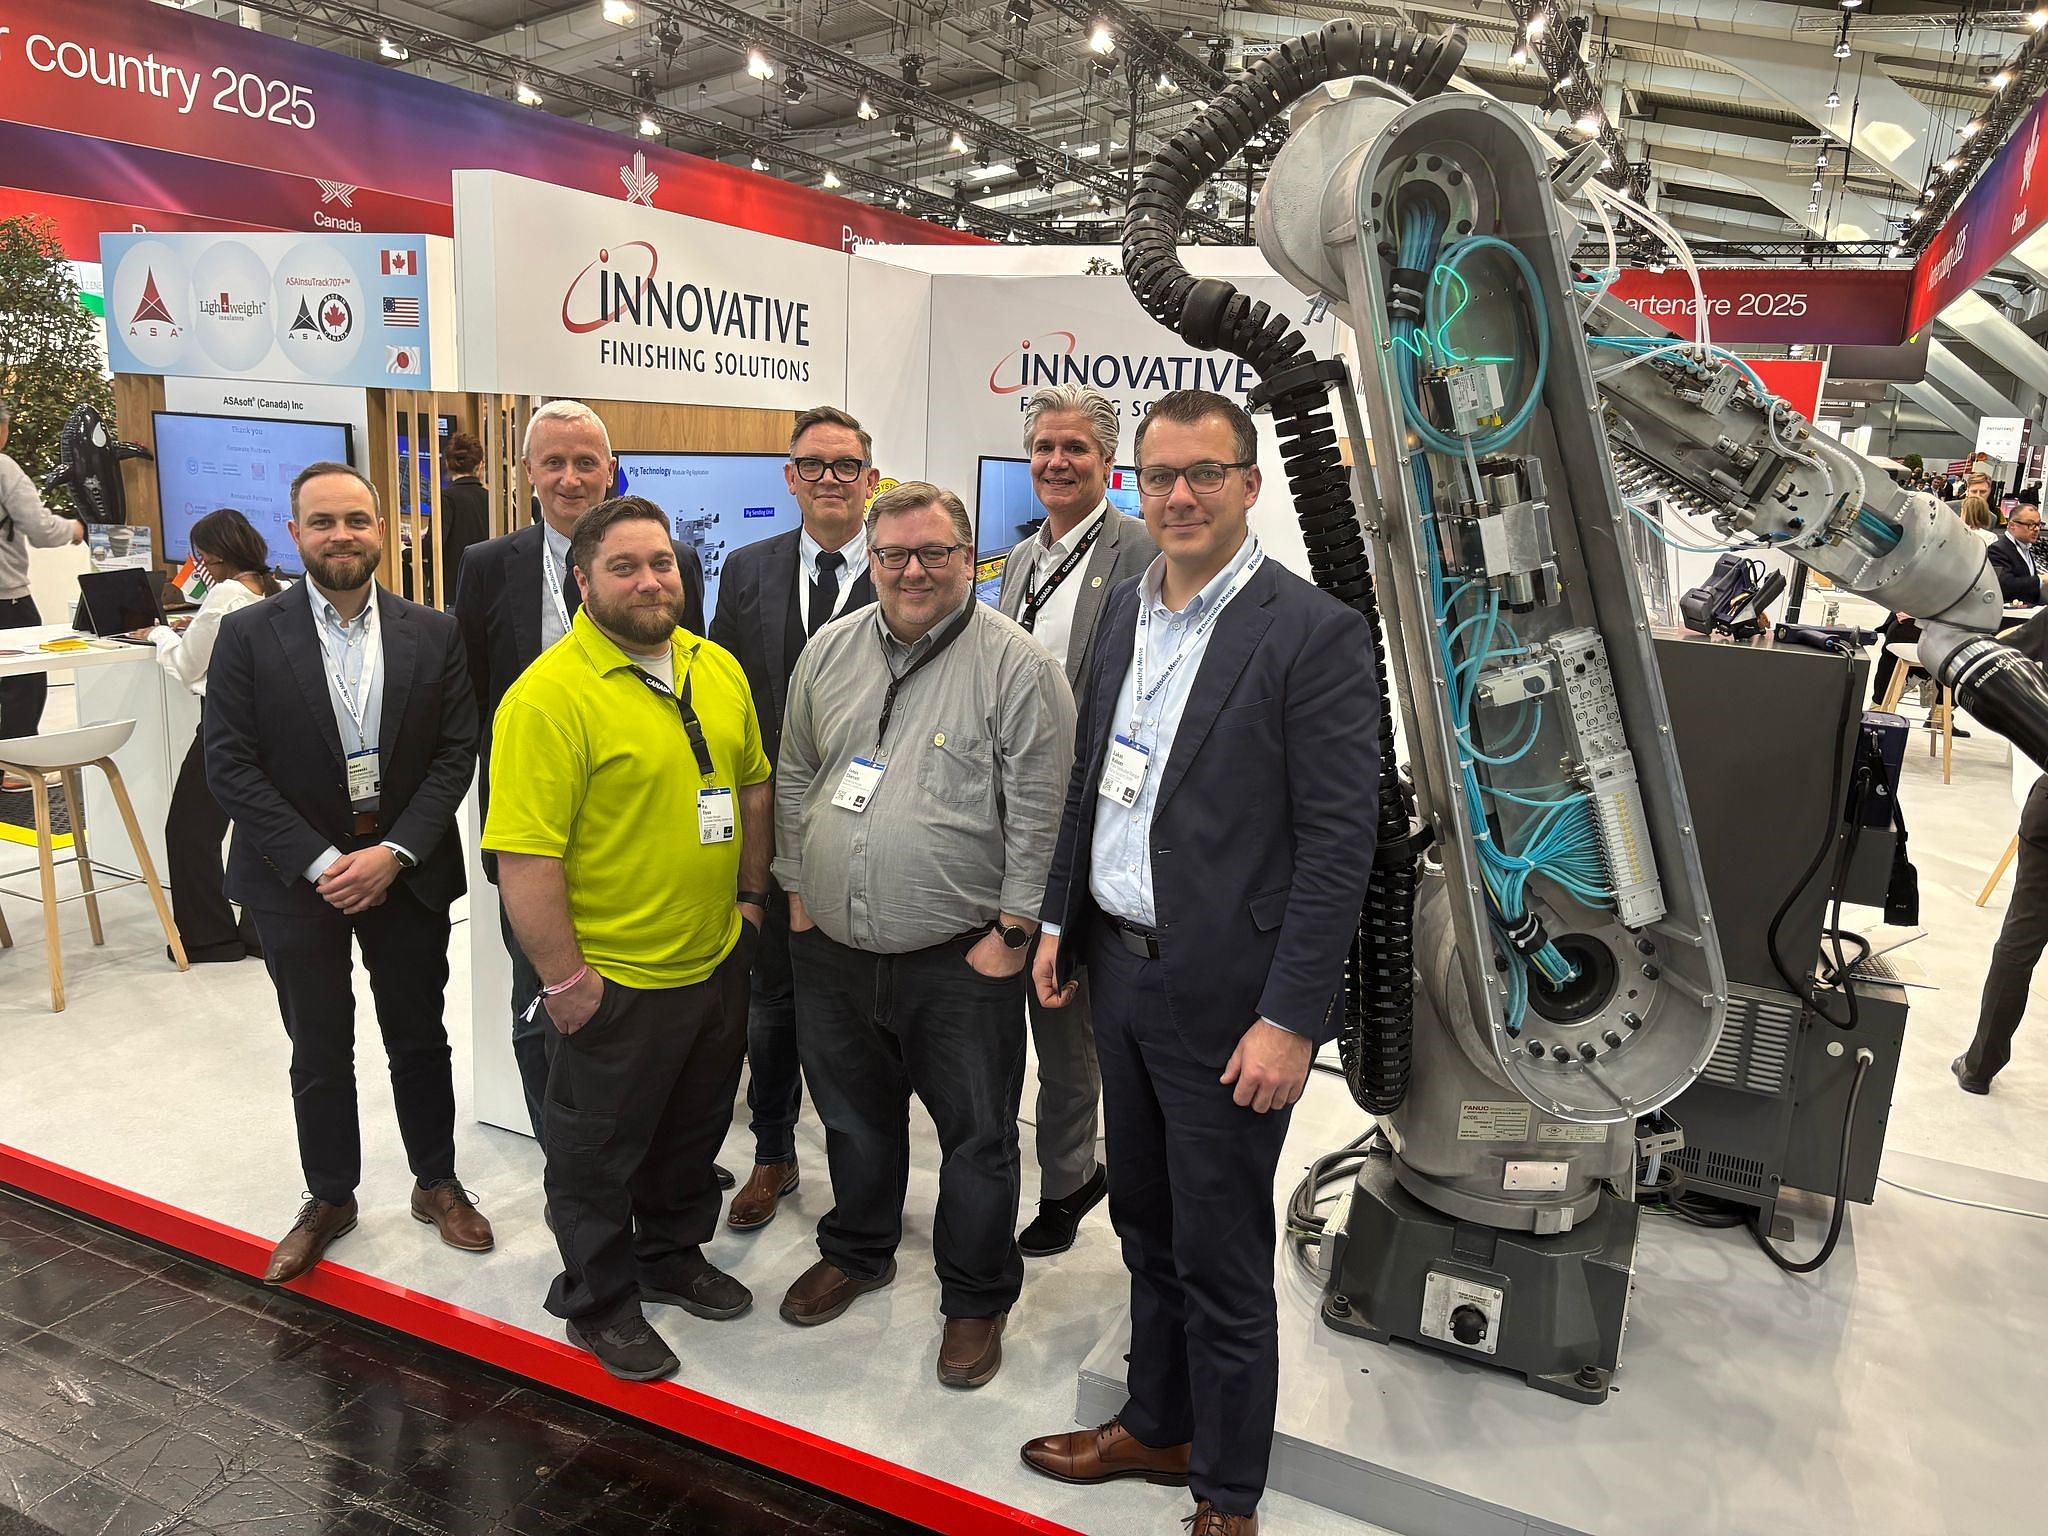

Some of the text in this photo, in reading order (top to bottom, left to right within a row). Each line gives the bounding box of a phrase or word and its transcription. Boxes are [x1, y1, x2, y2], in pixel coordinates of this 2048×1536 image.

[25, 34, 200, 114] country
[211, 66, 316, 130] 2025
[313, 211, 362, 233] Canada
[1621, 293, 1808, 317] artenaire 2025
[600, 339, 810, 382] FINISHING SOLUTIONS
[257, 398, 290, 411] (Canada)
[291, 401, 304, 410] Inc
[629, 467, 639, 477] Pig
[640, 467, 671, 477] Technology
[1087, 521, 1104, 540] CANADA
[1062, 552, 1080, 573] CANADA
[1035, 585, 1053, 607] CANADA
[1201, 585, 1237, 629] Deutsche Messe
[1150, 653, 1184, 696] Deutsche Messe
[1974, 666, 1999, 688] SAMES
[646, 678, 672, 694] CANADA
